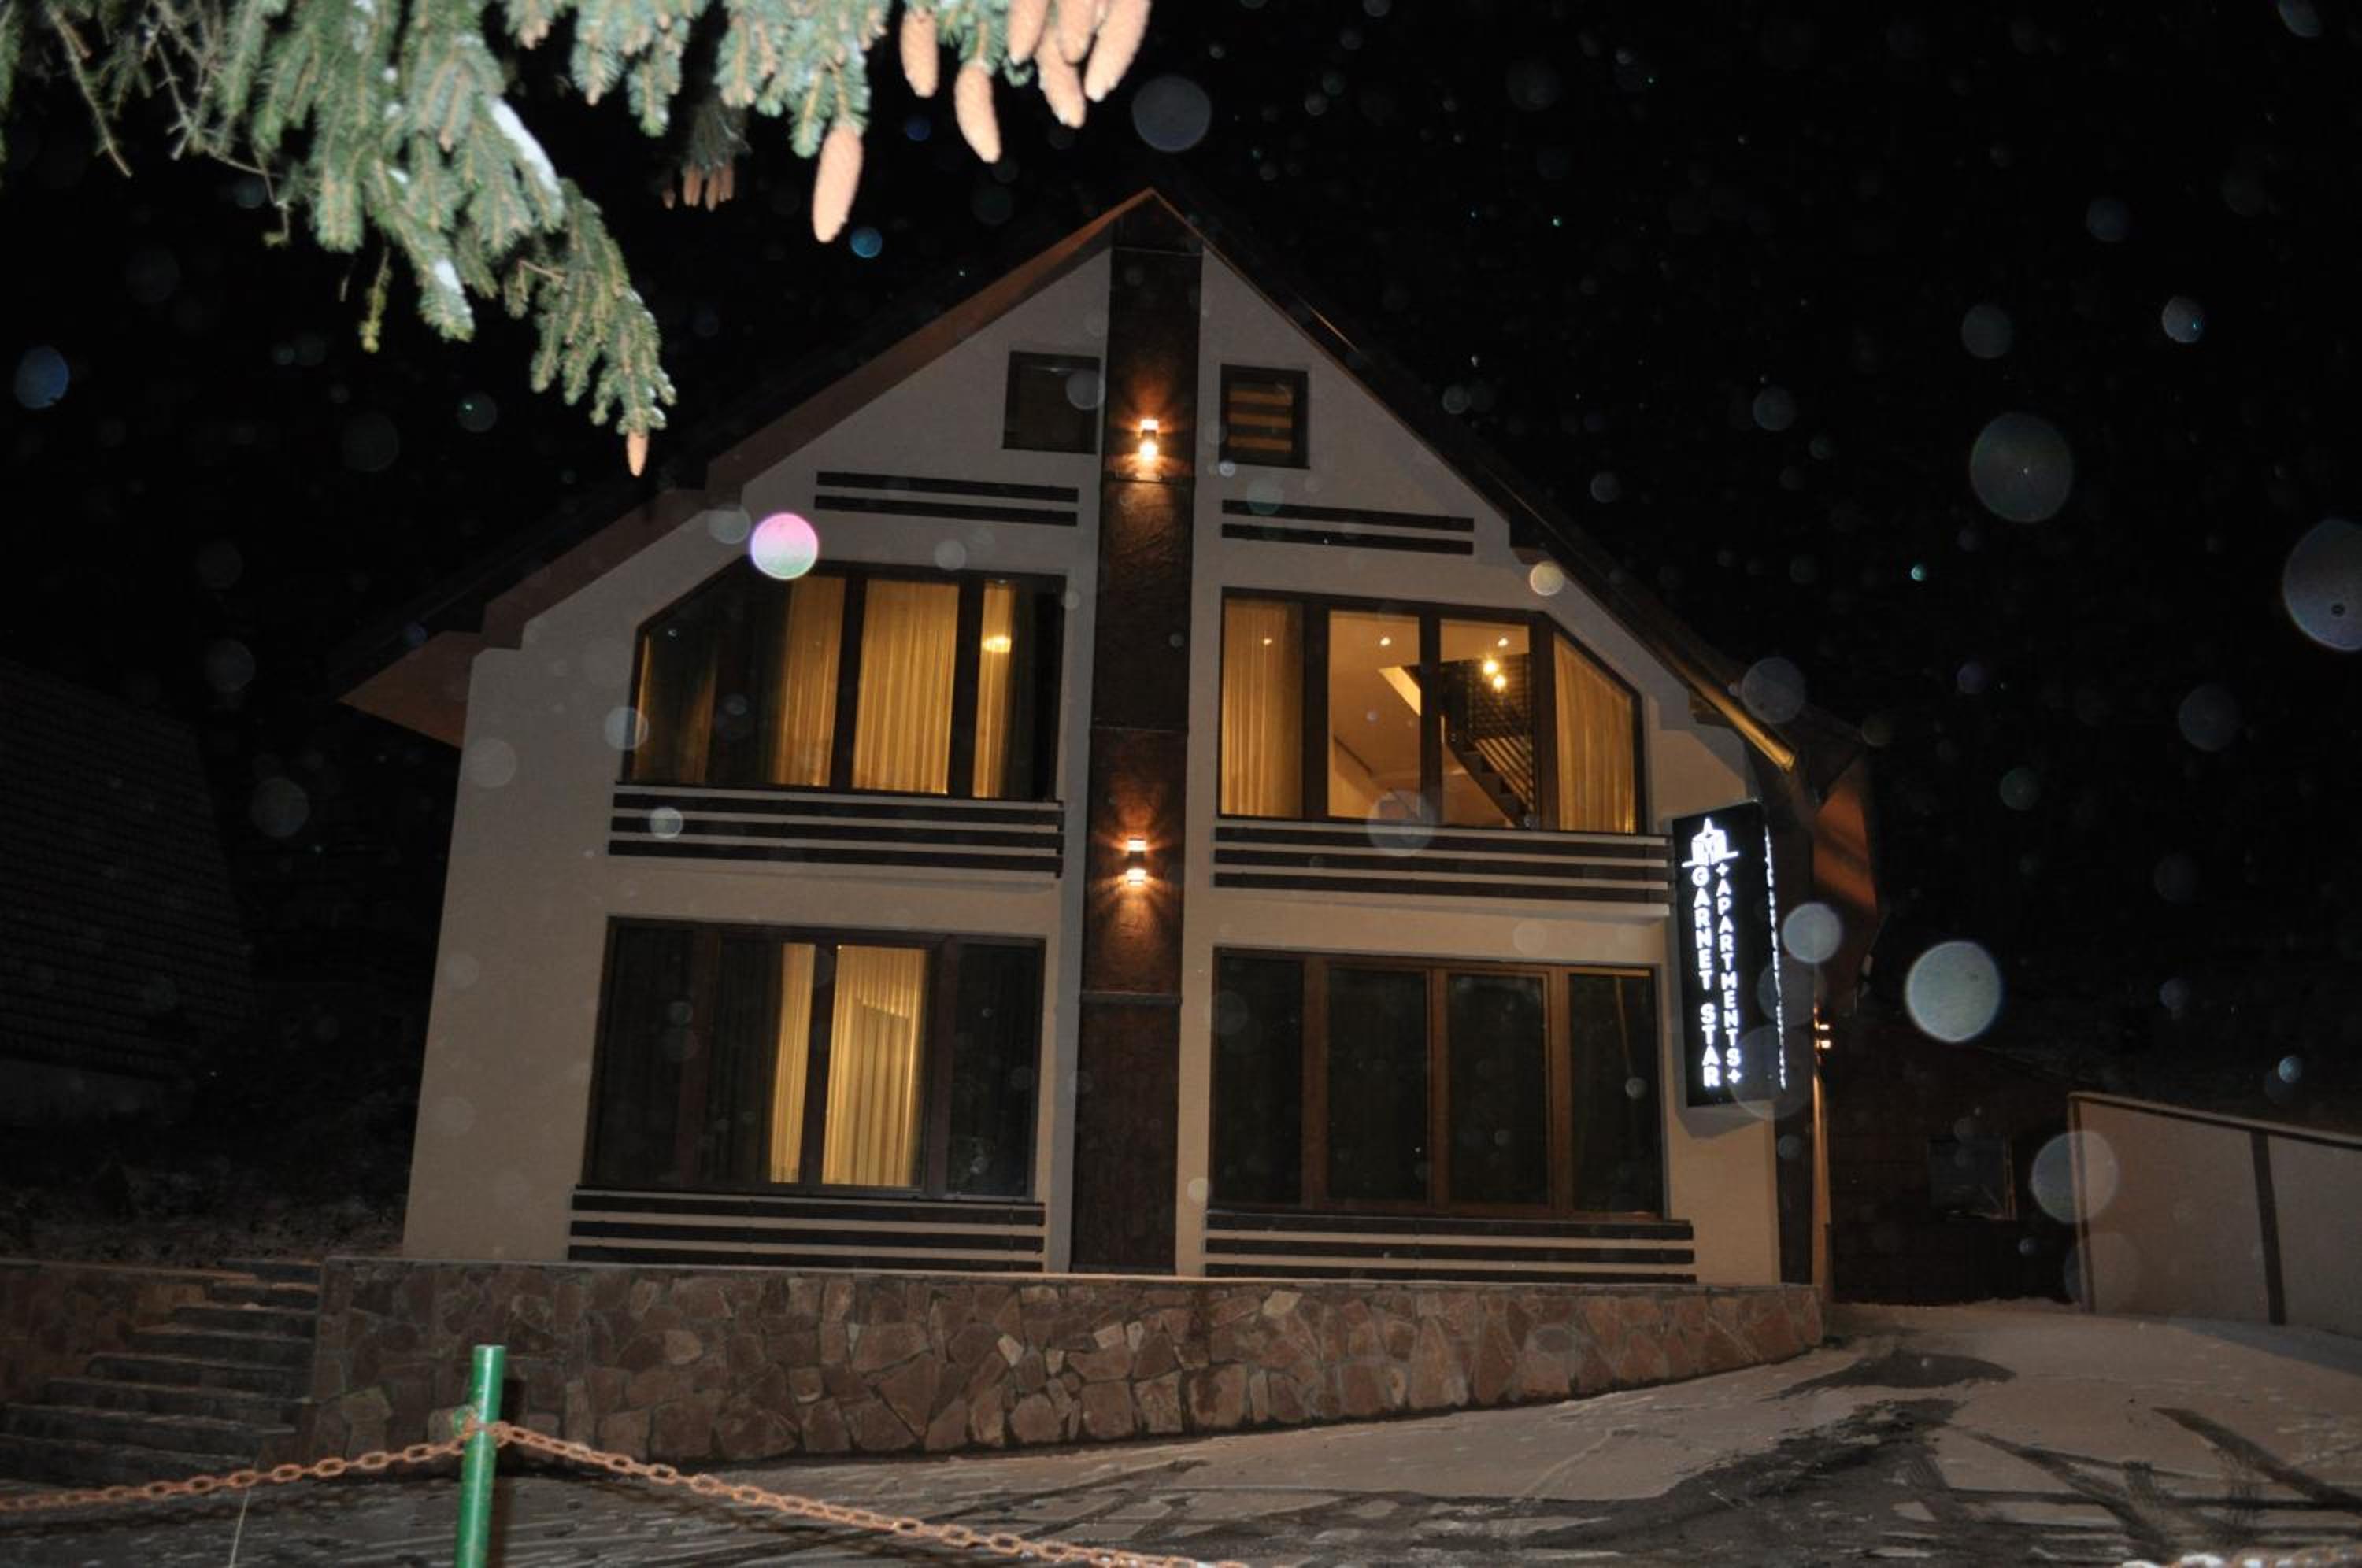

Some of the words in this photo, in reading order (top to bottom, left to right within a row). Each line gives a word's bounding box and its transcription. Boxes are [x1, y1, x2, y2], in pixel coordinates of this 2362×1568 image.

[1692, 866, 1713, 990] GARNET
[1716, 879, 1741, 1066] APARTMENTS
[1701, 1003, 1721, 1088] STAR
